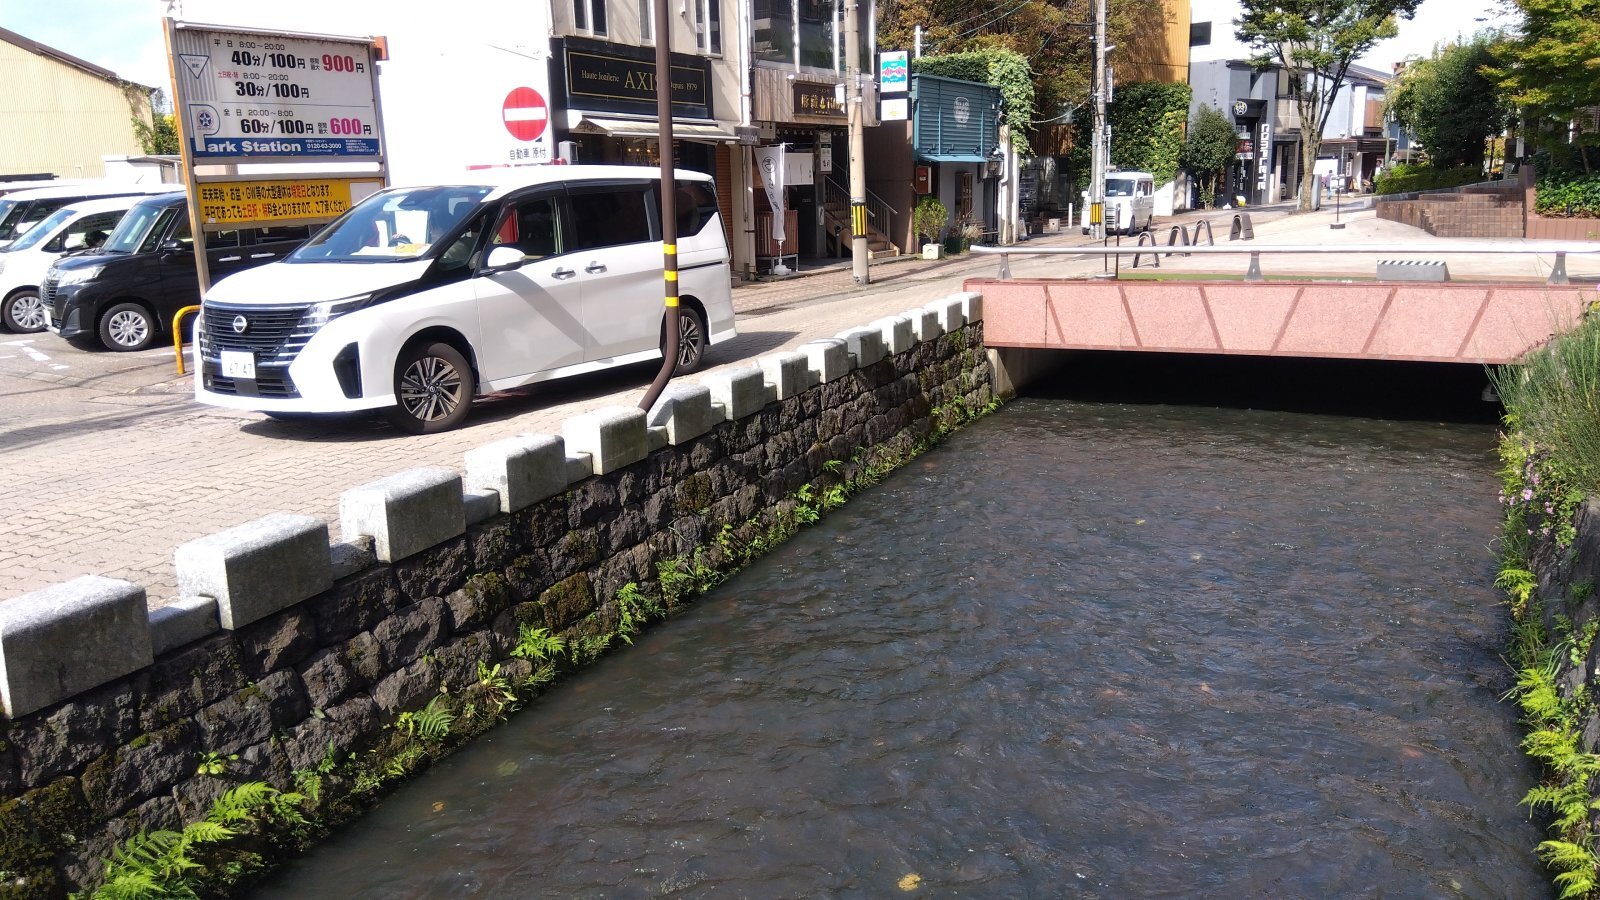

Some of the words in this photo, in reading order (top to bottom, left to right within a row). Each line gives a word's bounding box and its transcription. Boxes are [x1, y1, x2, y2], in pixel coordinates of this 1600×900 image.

[232, 51, 305, 69] 40分/100円
[322, 54, 364, 73] 900円
[235, 81, 309, 98] 30分/100円
[671, 82, 684, 91] epuis
[686, 82, 698, 91] 1979
[241, 118, 314, 134] 60分/100円
[330, 118, 372, 135] 600円
[241, 140, 301, 153] Station
[509, 148, 530, 160] 自動車
[532, 147, 546, 159] 原付
[1257, 123, 1270, 191] COMPLETE
